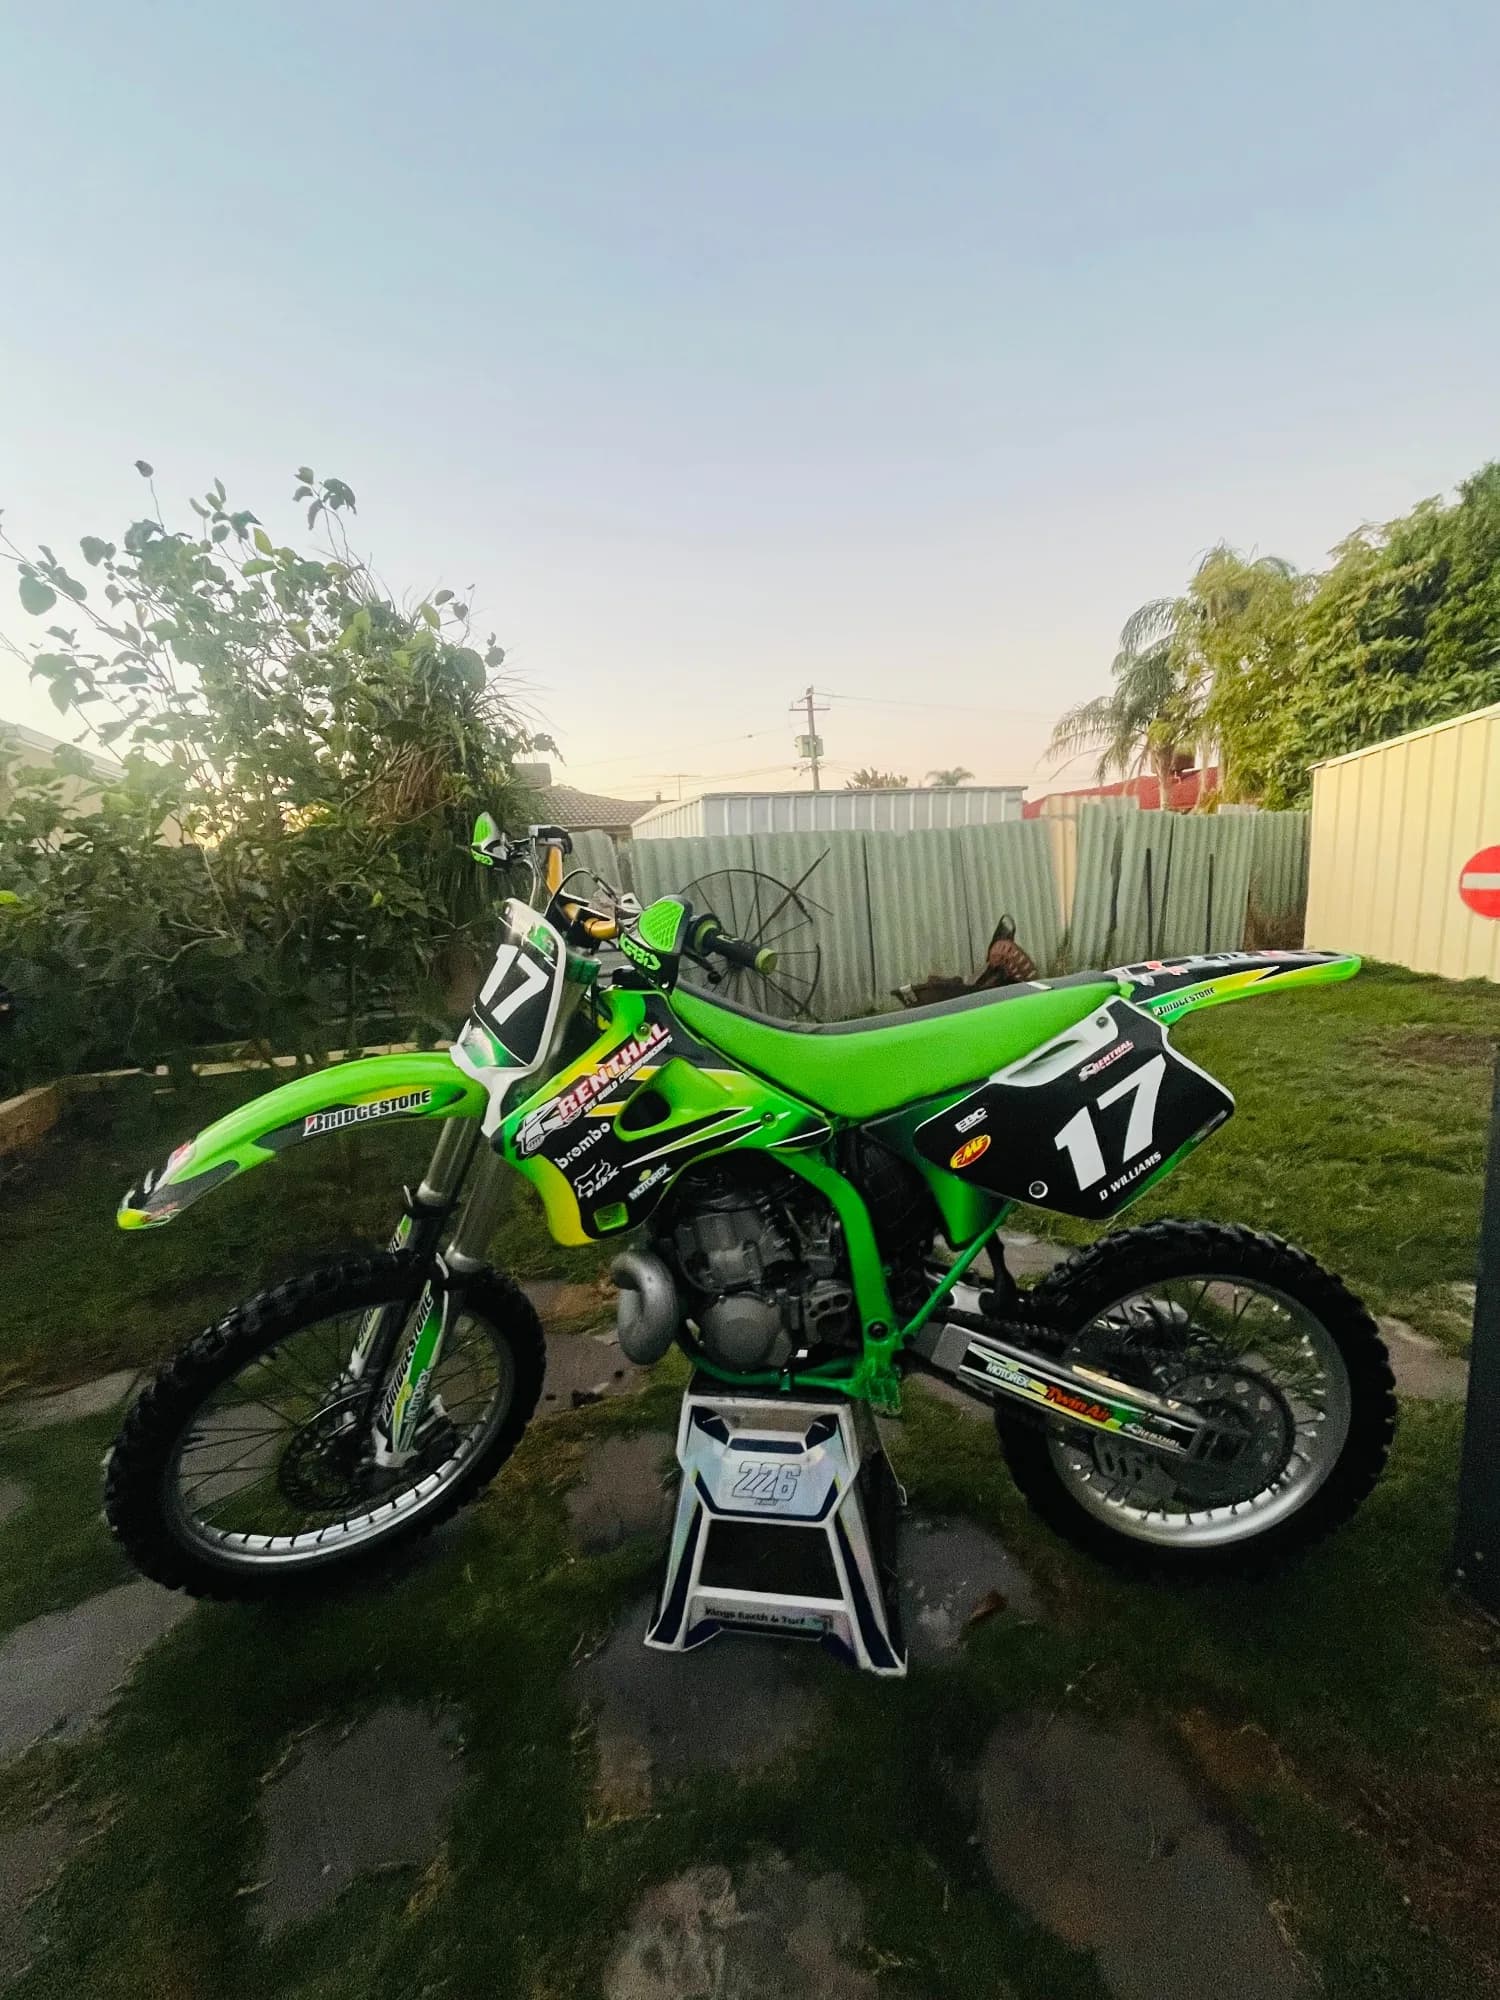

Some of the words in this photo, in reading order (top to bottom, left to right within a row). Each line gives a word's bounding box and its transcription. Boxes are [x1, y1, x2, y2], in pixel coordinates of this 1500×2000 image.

[479, 943, 550, 1026] 17
[1153, 986, 1216, 1017] BRIDGESTONE
[557, 1023, 670, 1120] RENTHAL
[597, 1080, 619, 1102] BUILD
[302, 1088, 432, 1138] BRIDGESTONE
[954, 1107, 987, 1132] EBC
[1053, 1053, 1167, 1192] 17
[553, 1121, 612, 1170] brembo
[627, 1163, 671, 1201] MOTOREX
[1098, 1188, 1109, 1201] D
[1109, 1151, 1162, 1193] WILLIAMS
[985, 1360, 1031, 1388] MOTOREX
[732, 1460, 802, 1502] 226
